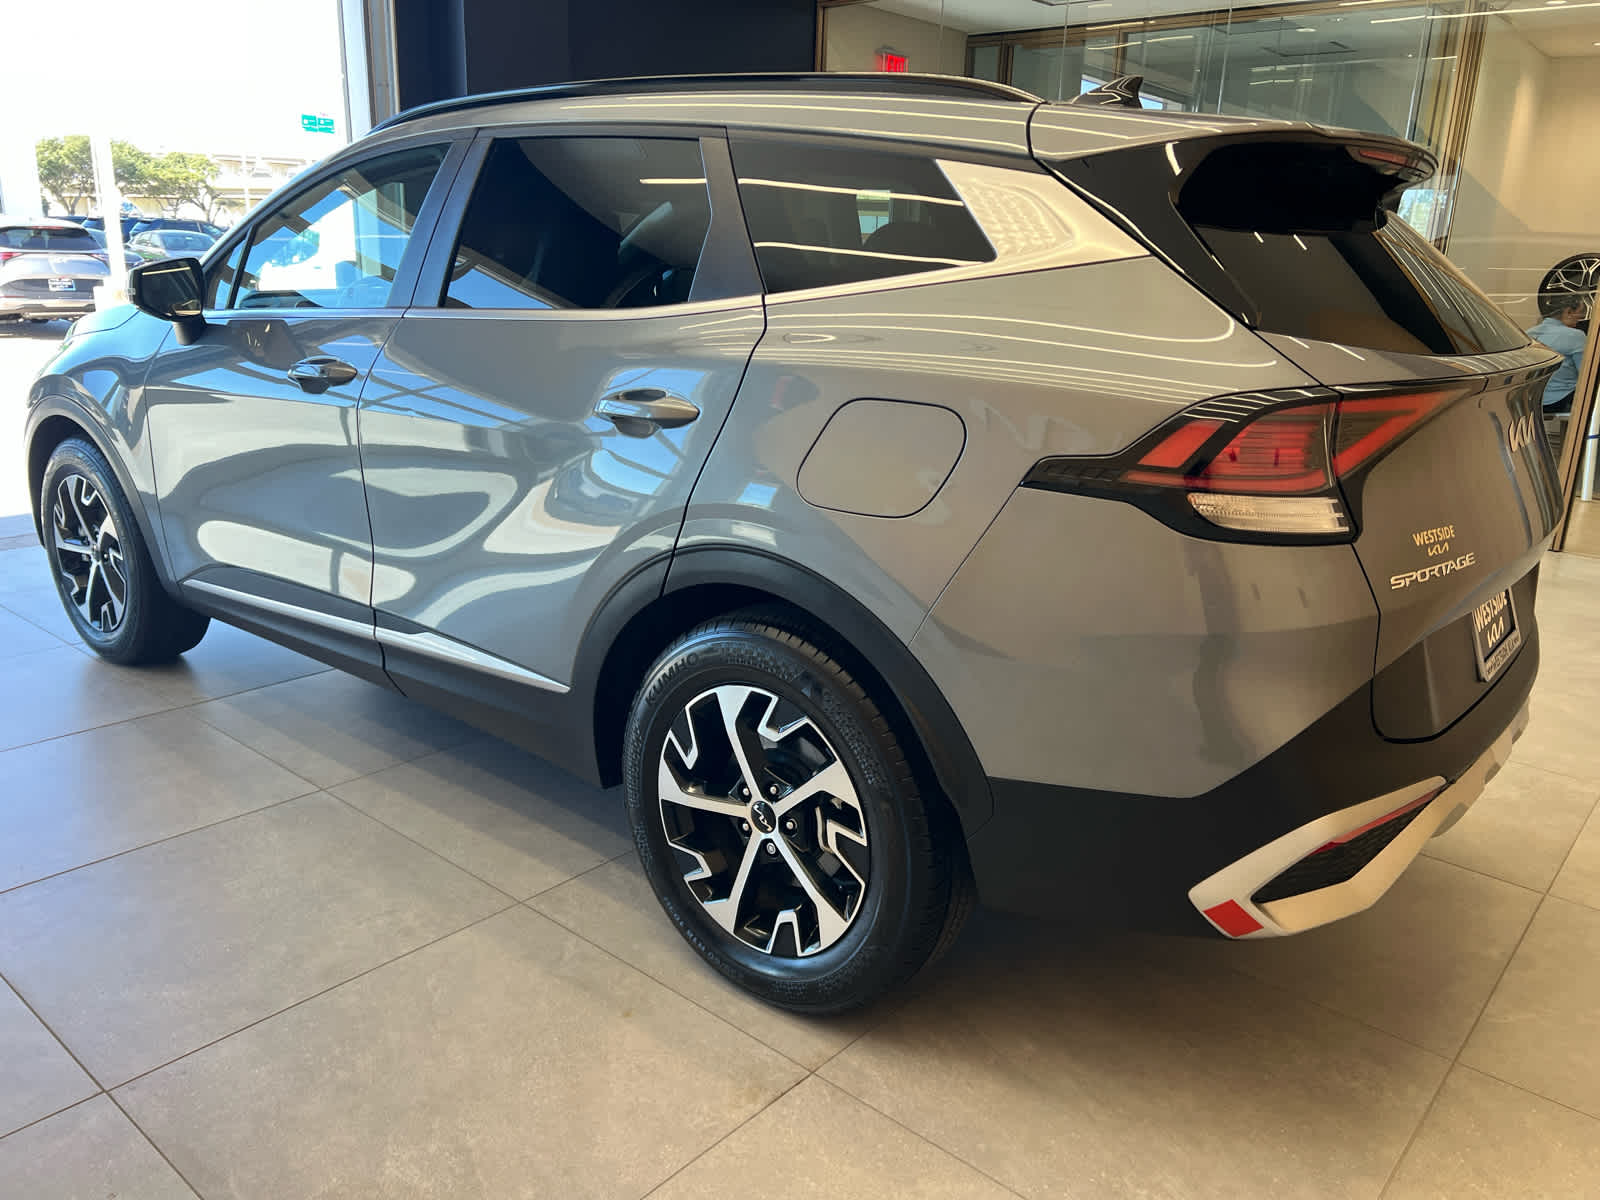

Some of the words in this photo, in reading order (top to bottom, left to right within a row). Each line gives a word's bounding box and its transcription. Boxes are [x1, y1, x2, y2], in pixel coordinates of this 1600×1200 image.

[1412, 524, 1456, 546] WESTSIDE
[1427, 541, 1449, 556] KIA
[1390, 552, 1476, 590] SPORTAGE
[1487, 616, 1504, 648] KIA
[646, 652, 698, 705] KUMHO
